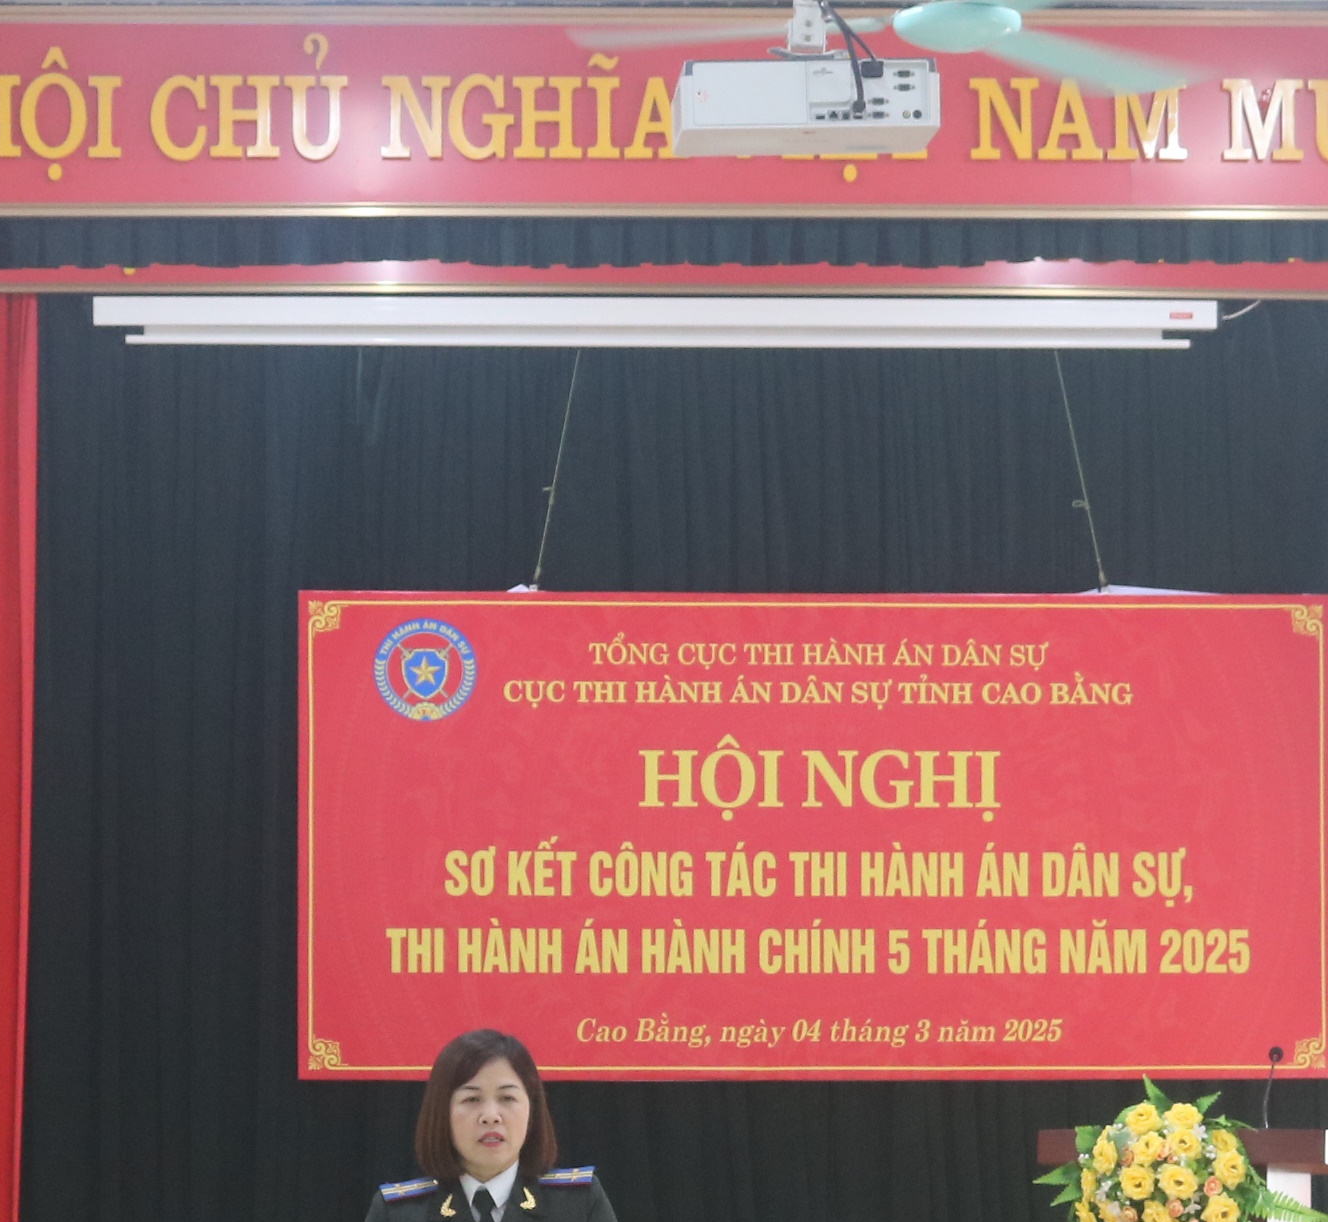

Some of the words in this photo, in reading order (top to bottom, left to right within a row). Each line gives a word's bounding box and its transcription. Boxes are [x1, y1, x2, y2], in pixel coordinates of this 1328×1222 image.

[149, 33, 349, 162] CHỦ
[380, 53, 691, 160] NGHĨA
[968, 75, 1188, 162] NAM
[589, 632, 669, 666] TỔNG
[677, 643, 737, 669] CỤC
[743, 643, 794, 666] THI
[803, 638, 885, 667] HÀNH
[893, 637, 934, 667] ÁN
[943, 638, 1003, 667] DÂN
[1010, 641, 1049, 671] SỰ
[503, 680, 566, 708] CỤC
[573, 680, 627, 704] THI
[636, 675, 722, 704] HÀNH
[730, 674, 772, 704] ÁN
[780, 675, 843, 705] DÂN
[851, 679, 893, 710] SỰ
[900, 674, 974, 705] TỈNH
[981, 681, 1043, 705] CAO
[1050, 672, 1133, 705] BẰNG
[639, 733, 785, 821] HỘI
[801, 748, 1002, 823] NGHỊ
[444, 845, 498, 897] SƠ
[507, 835, 579, 897] KẾT
[588, 841, 695, 898] CÔNG
[705, 841, 779, 898] TÁC
[788, 851, 849, 897] THI
[860, 841, 966, 898] HÀNH
[975, 841, 1031, 898] ÁN
[1041, 842, 1121, 898] DÂN
[1132, 847, 1195, 909] SỰ,
[385, 927, 446, 974] THI
[457, 917, 564, 975] HÀNH
[574, 917, 630, 975] ÁN
[641, 917, 747, 975] HÀNH
[758, 918, 877, 975] CHÍNH
[887, 928, 912, 975] 5
[921, 918, 1049, 975] THÁNG
[1059, 919, 1149, 975] NĂM
[1159, 927, 1252, 975] 2025
[576, 1018, 629, 1043] Cao
[636, 1012, 713, 1048] Bằng,
[720, 1019, 785, 1048] ngày
[791, 1019, 822, 1043] 04
[830, 1018, 909, 1048] tháng
[915, 1019, 932, 1043] 3
[938, 1020, 996, 1043] năm
[1002, 1018, 1064, 1043] 2025
